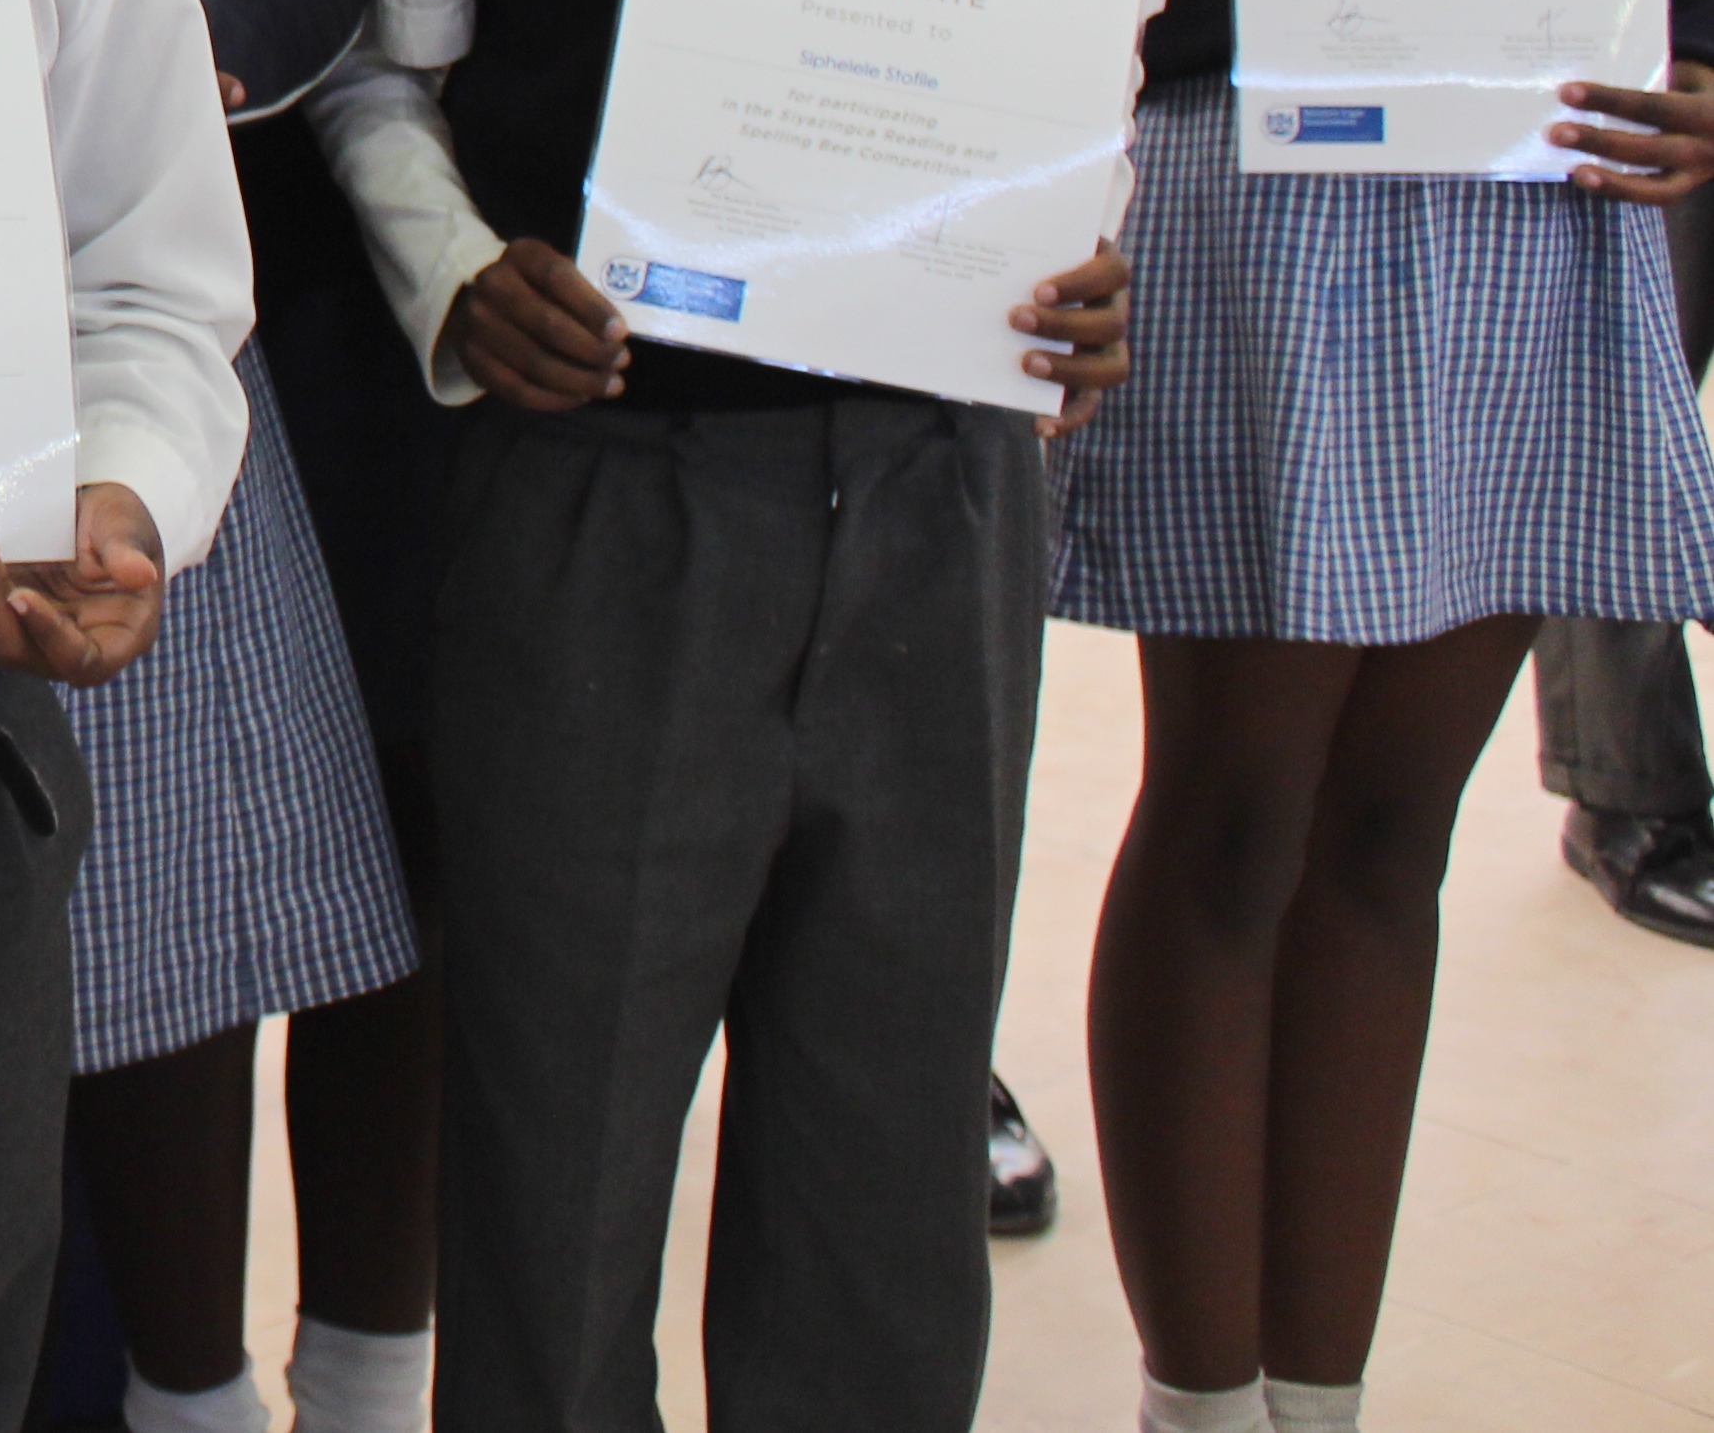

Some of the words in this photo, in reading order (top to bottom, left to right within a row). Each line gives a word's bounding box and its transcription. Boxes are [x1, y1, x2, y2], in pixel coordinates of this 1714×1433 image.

[929, 24, 952, 43] to
[744, 100, 773, 119] the
[882, 127, 957, 158] Reading
[818, 96, 939, 132] participating
[858, 145, 973, 179] Competition
